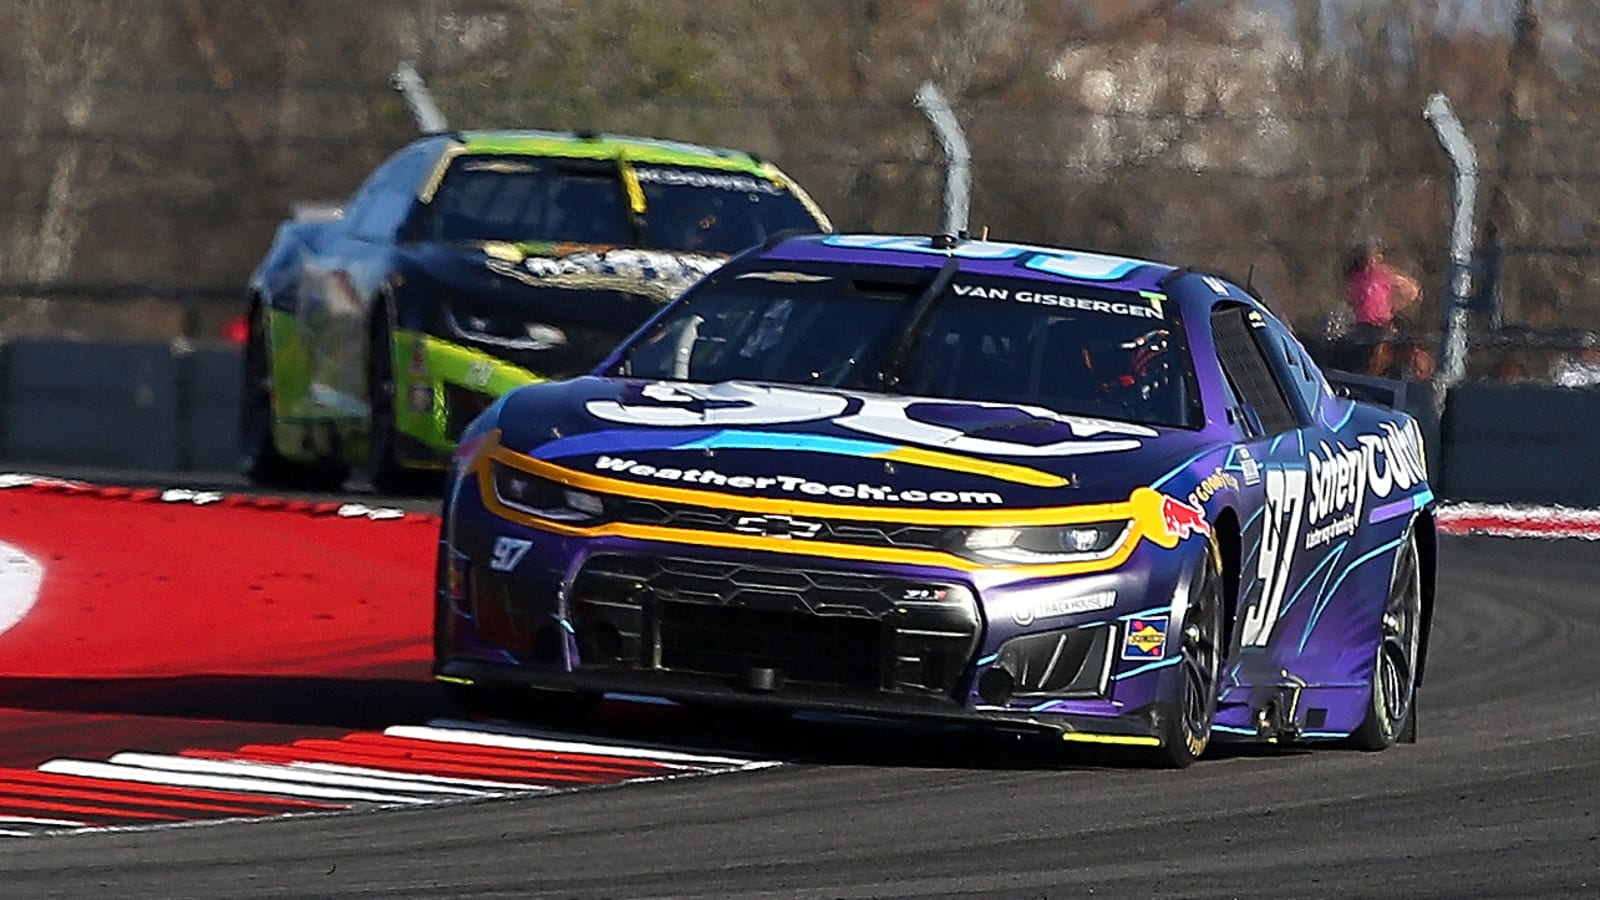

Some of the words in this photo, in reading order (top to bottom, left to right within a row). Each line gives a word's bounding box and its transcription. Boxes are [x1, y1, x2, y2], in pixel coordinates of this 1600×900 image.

[953, 284, 1008, 301] VAN
[1015, 291, 1165, 321] GISBERGEN
[595, 455, 1003, 505] WeatherTech.com
[490, 536, 534, 572] 97
[1240, 469, 1307, 648] 97
